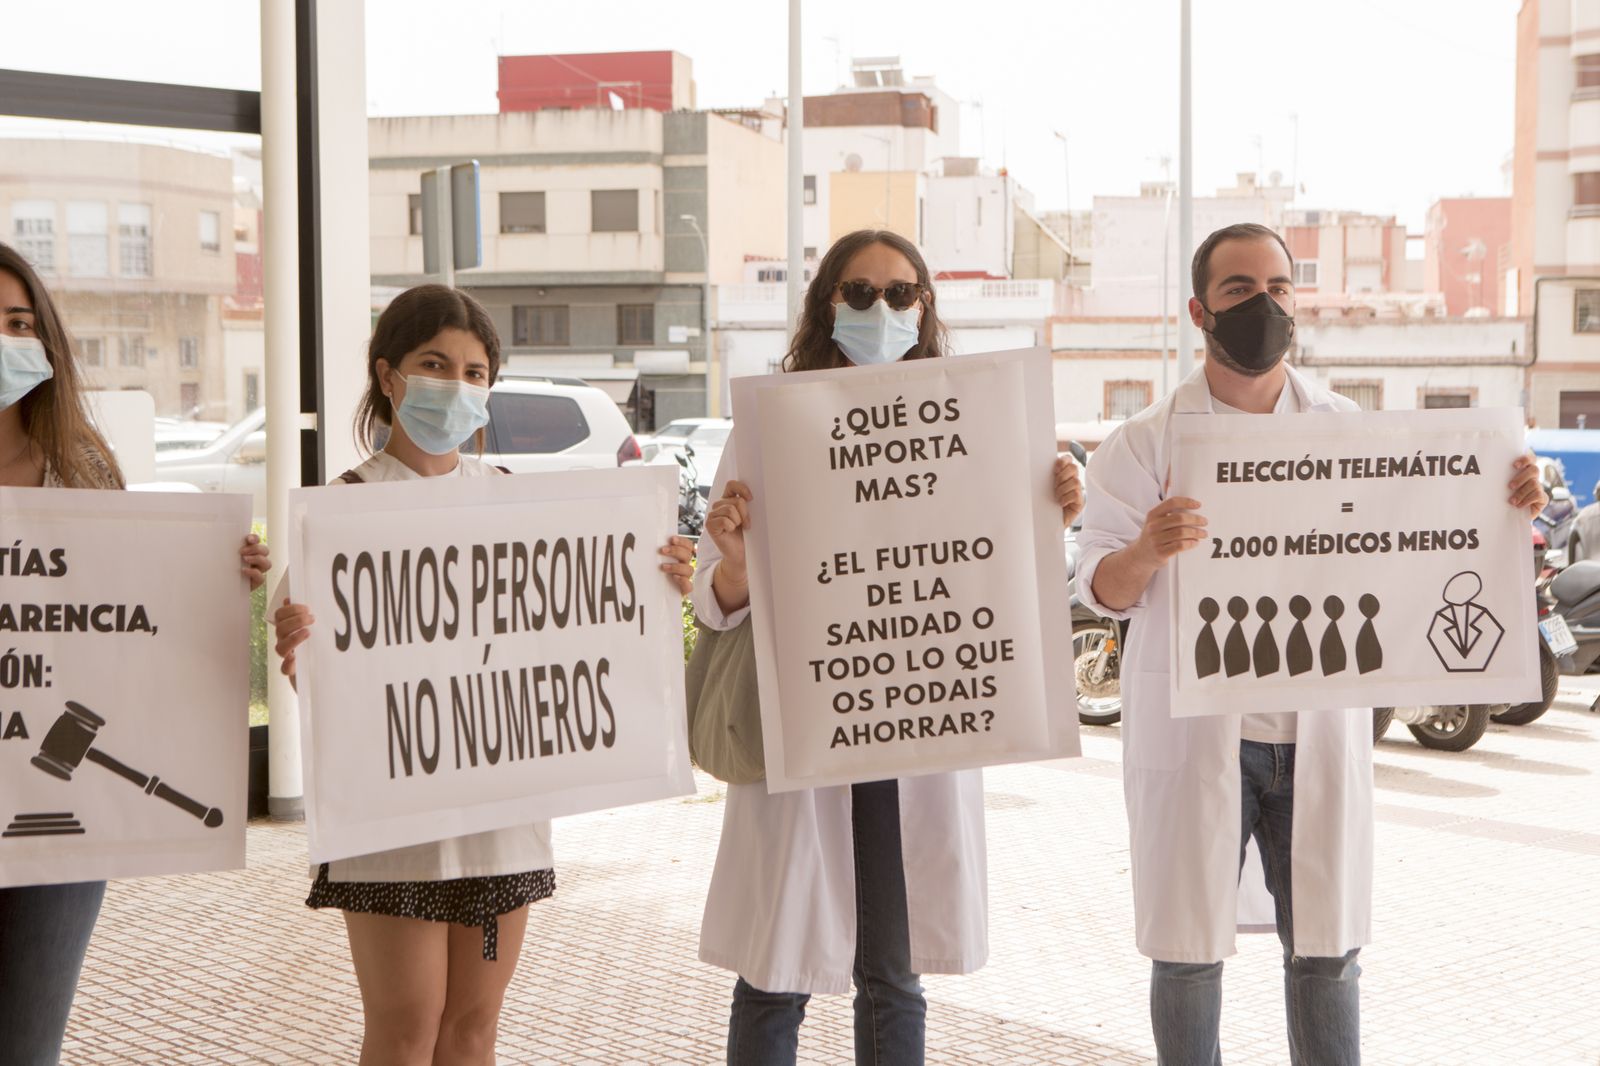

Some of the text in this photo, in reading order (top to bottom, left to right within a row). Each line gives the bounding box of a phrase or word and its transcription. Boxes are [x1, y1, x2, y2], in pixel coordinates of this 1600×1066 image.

[830, 395, 960, 441] ¿QUÉ OS
[828, 433, 968, 471] IMPORTA
[1216, 450, 1481, 483] ELECCIÓN TELEMÁTICA
[855, 472, 938, 503] MAS?
[1341, 502, 1354, 513] =
[0, 539, 68, 578] TÍAS
[817, 536, 994, 585] ¿EL FUTURO
[1210, 528, 1480, 559] 2.000 MÉDICOS MENOS
[331, 532, 645, 653] SOMOS PERSONAS,
[866, 576, 951, 608] DE LA
[0, 603, 159, 637] ARENCIA,
[826, 606, 995, 647] SANIDAD O
[0, 647, 53, 689] ÓN:
[808, 638, 1015, 683] TODO LO QUE
[385, 643, 617, 780] NO NÚMEROS
[832, 675, 998, 714] OS PODAIS
[0, 711, 30, 741] A
[829, 709, 996, 749] AHORRAR?
